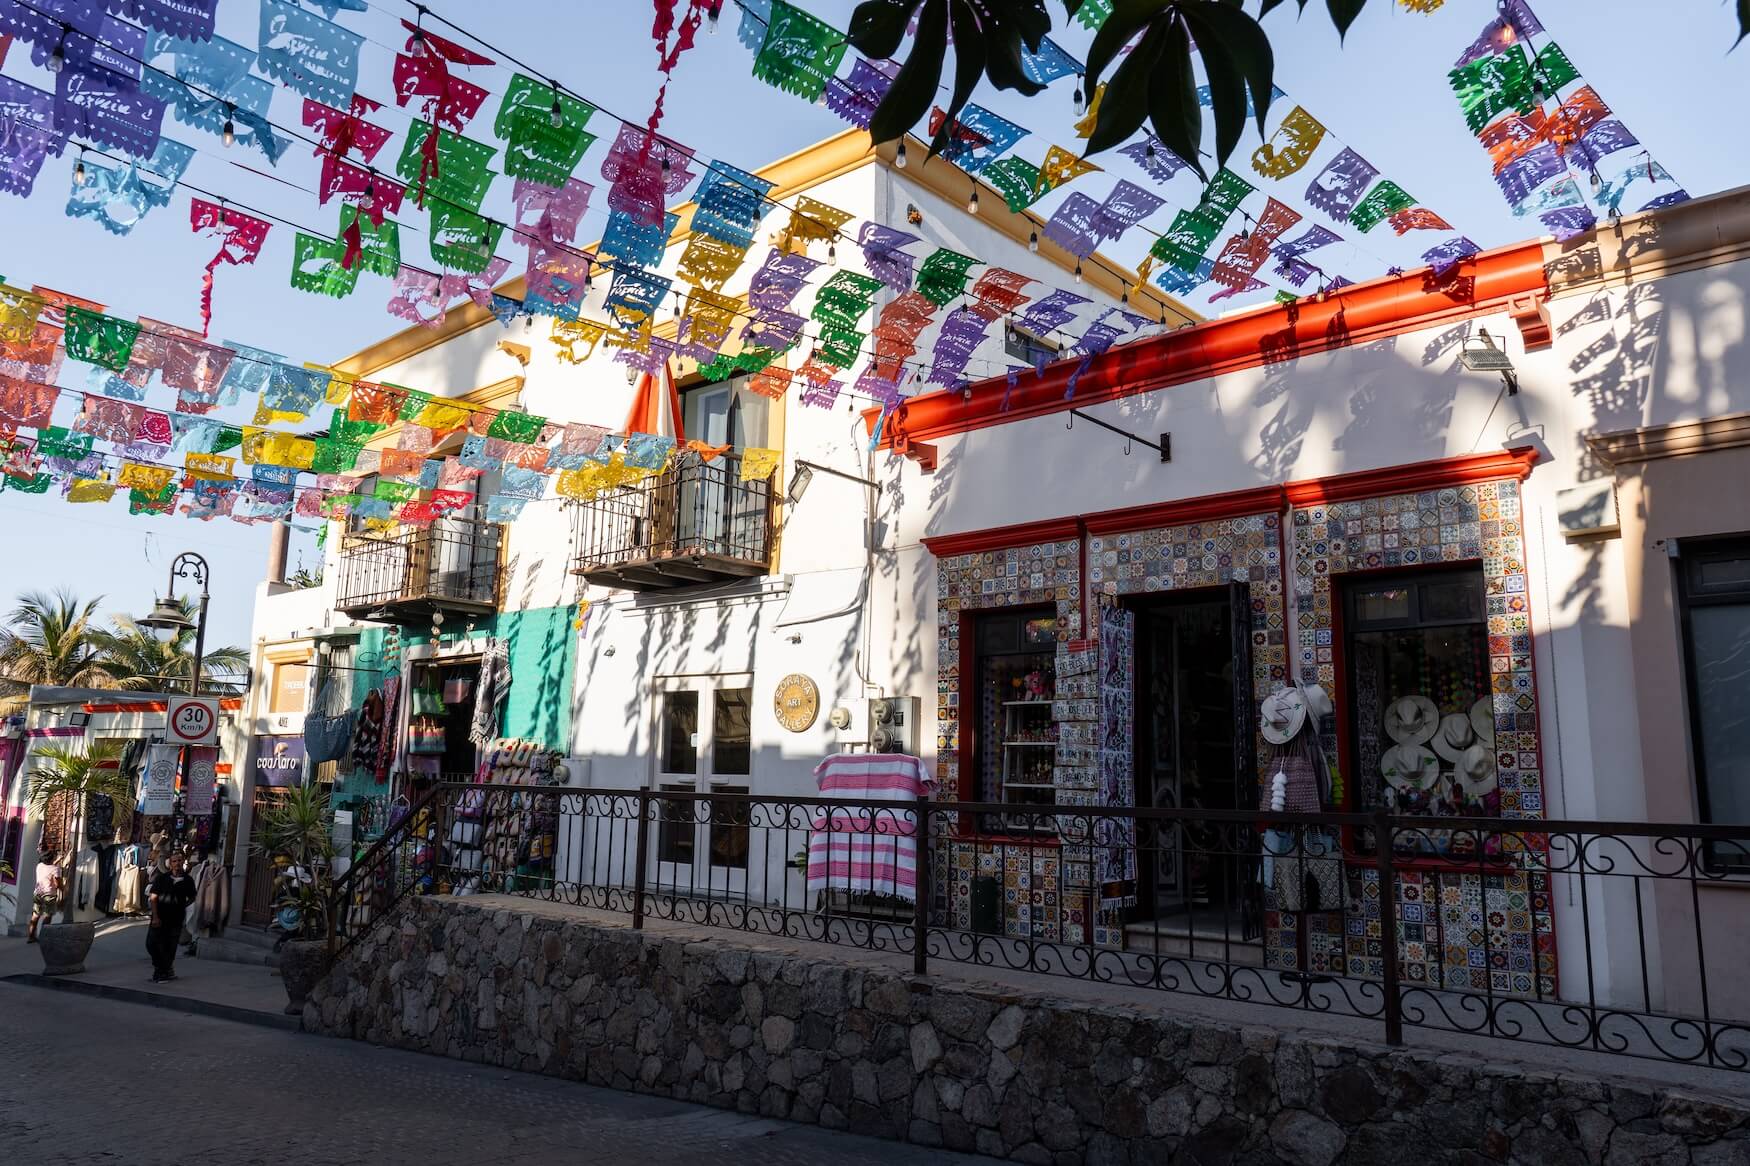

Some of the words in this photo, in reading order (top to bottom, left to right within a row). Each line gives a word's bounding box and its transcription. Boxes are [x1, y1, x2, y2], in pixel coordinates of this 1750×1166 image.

[776, 675, 813, 698] SORAYA
[786, 698, 800, 707] ART
[184, 707, 204, 723] 30
[776, 706, 813, 730] GALLERY
[181, 723, 205, 732] Km/h
